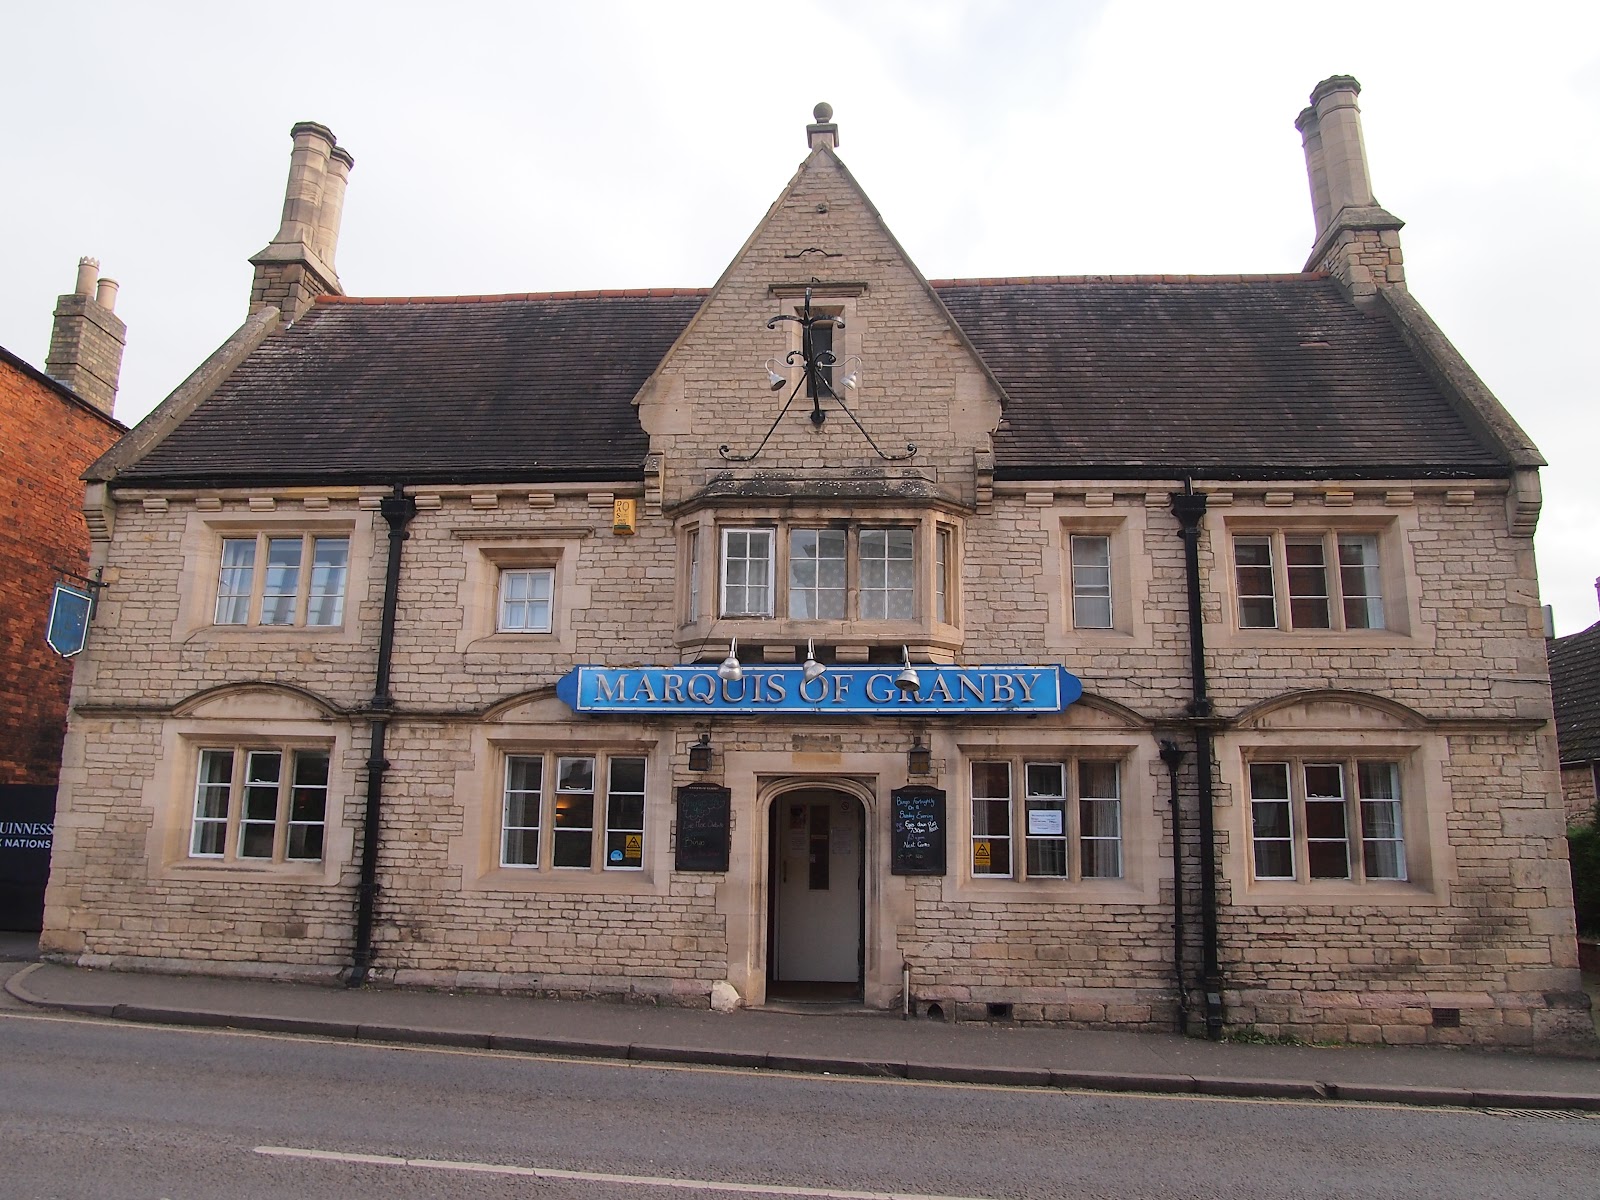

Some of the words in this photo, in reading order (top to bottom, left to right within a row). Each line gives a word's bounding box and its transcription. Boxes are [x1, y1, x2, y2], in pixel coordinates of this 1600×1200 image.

[594, 672, 787, 705] MARQUIS
[799, 673, 854, 703] OF
[0, 822, 54, 836] UINNESS
[4, 838, 52, 849] NATIONS
